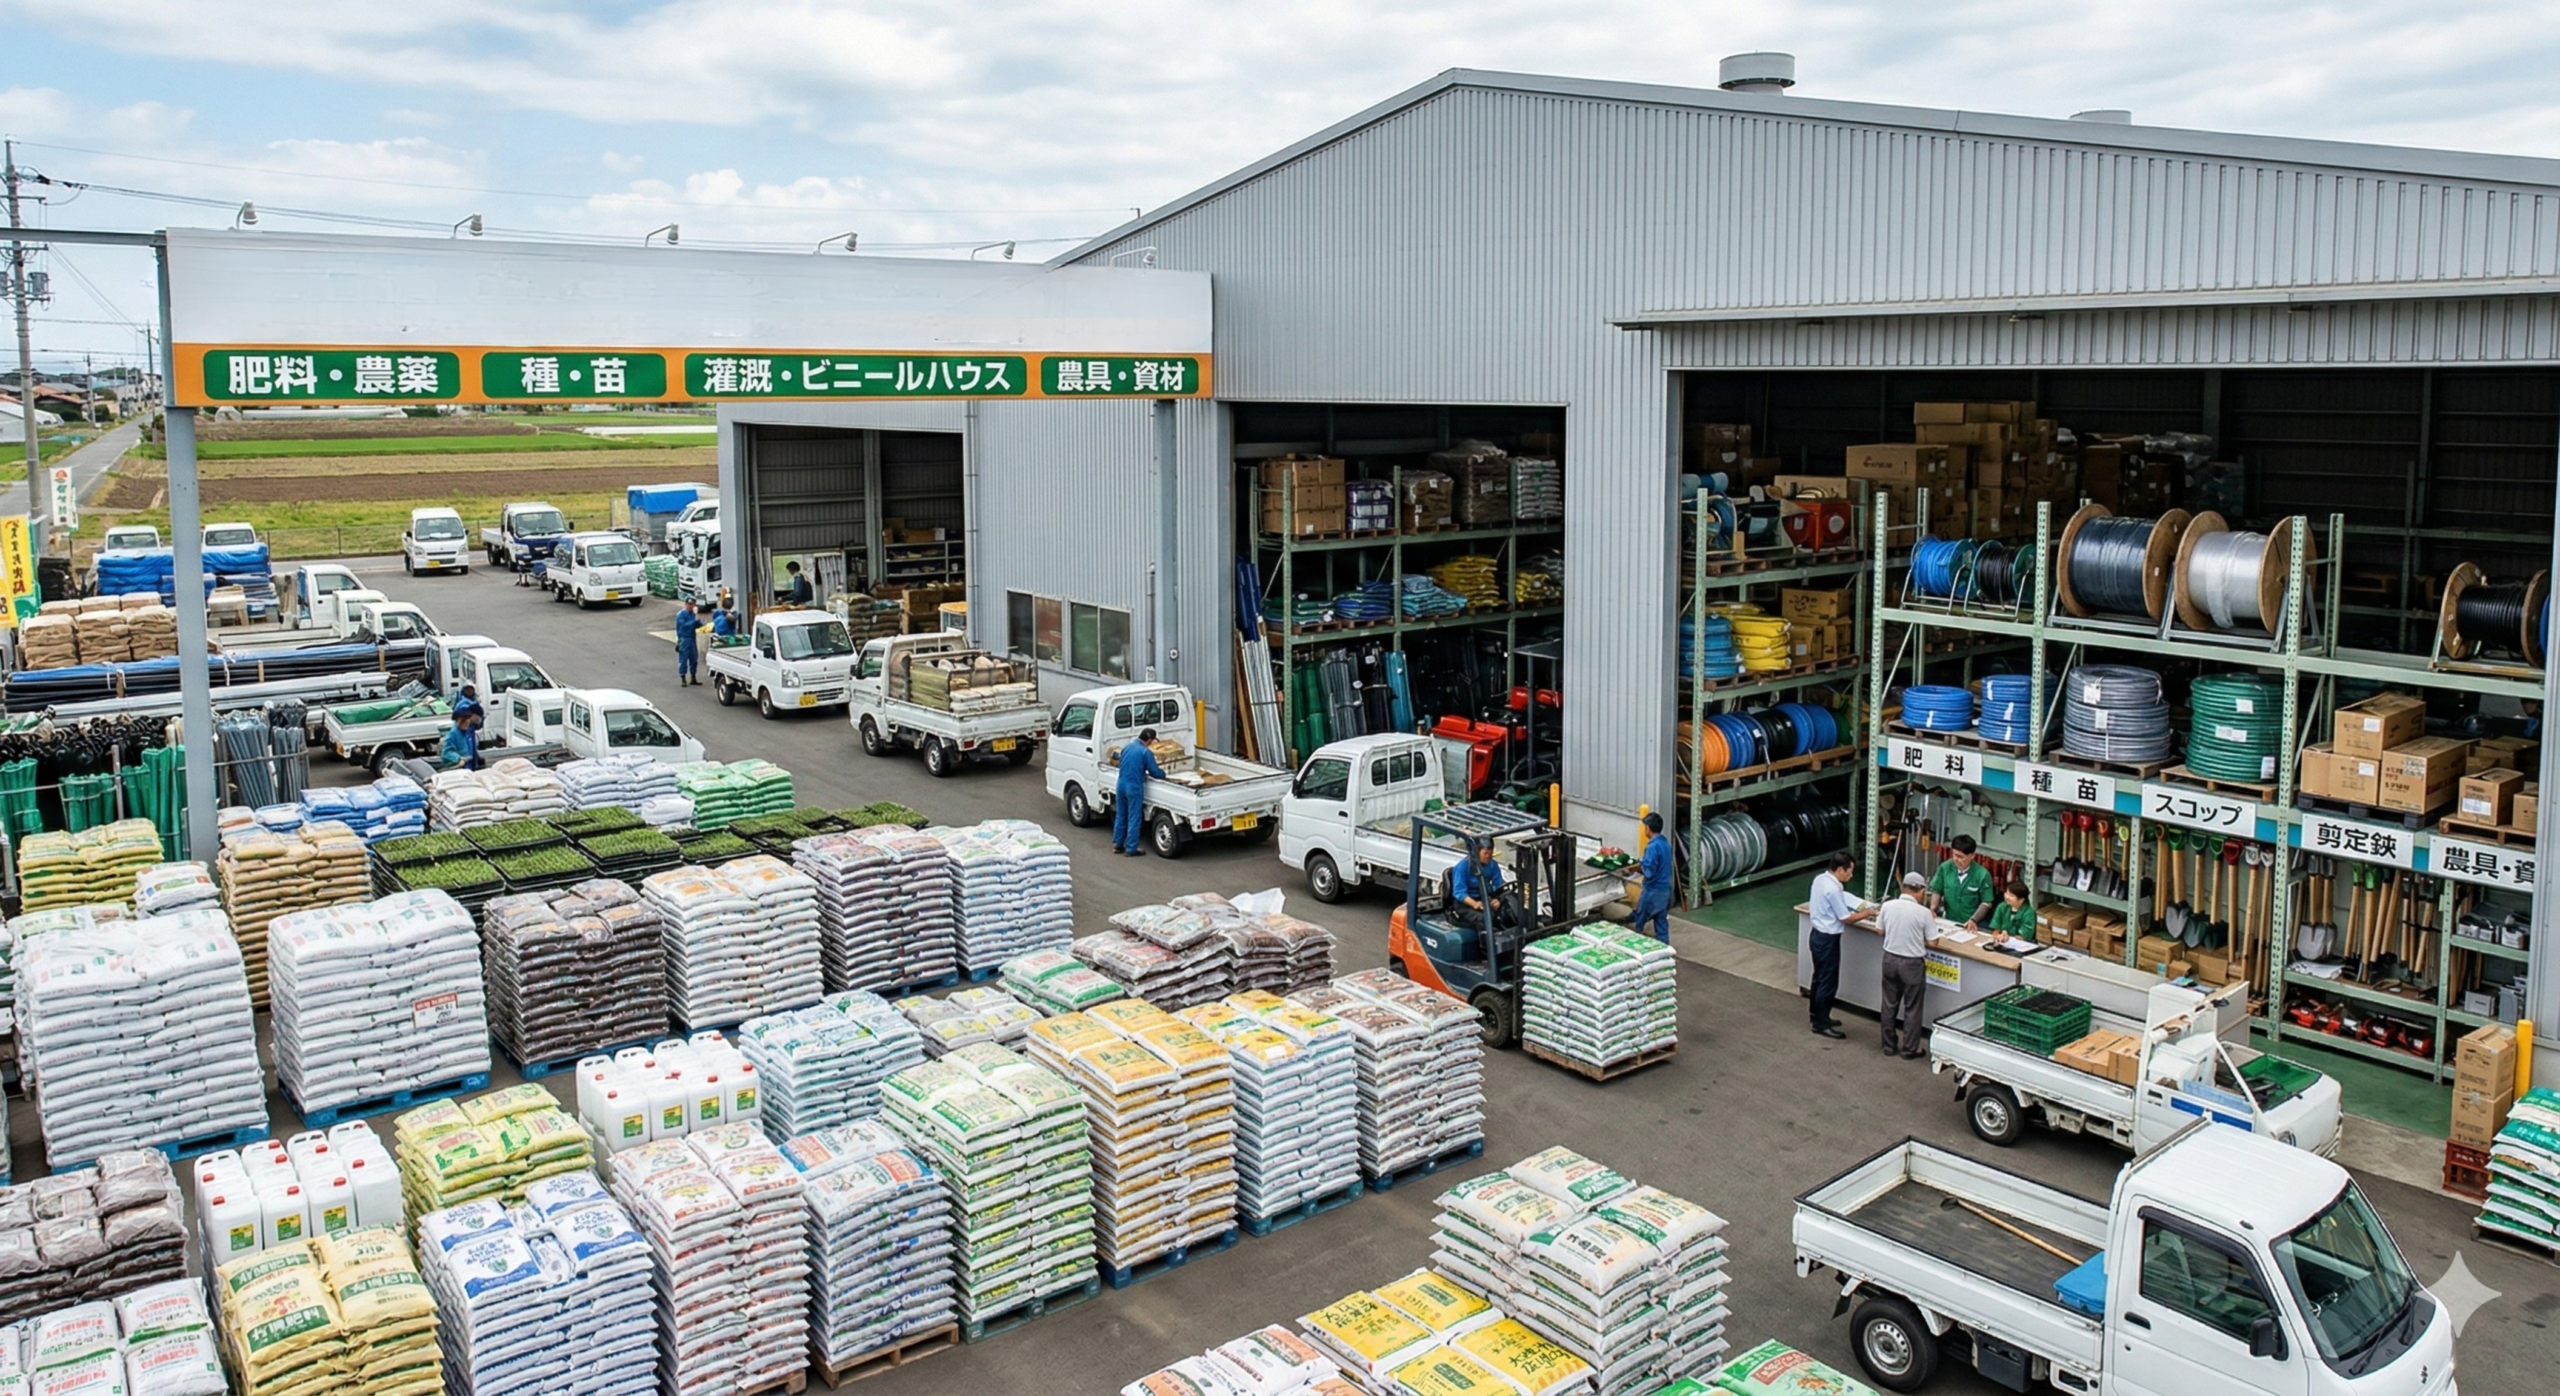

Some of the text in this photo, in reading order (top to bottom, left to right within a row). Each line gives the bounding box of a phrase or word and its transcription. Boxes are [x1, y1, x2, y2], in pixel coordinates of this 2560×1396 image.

[229, 355, 438, 394] 肥料・農薬
[521, 356, 627, 394] 種・苗
[703, 358, 1011, 393] 灌漑・ビニールハウス
[1057, 360, 1185, 392] 農具・資材
[1903, 746, 1965, 776] 肥料
[2031, 769, 2099, 802] 種苗
[2156, 793, 2242, 826] スコップ
[2316, 822, 2397, 859] 剪定鋏
